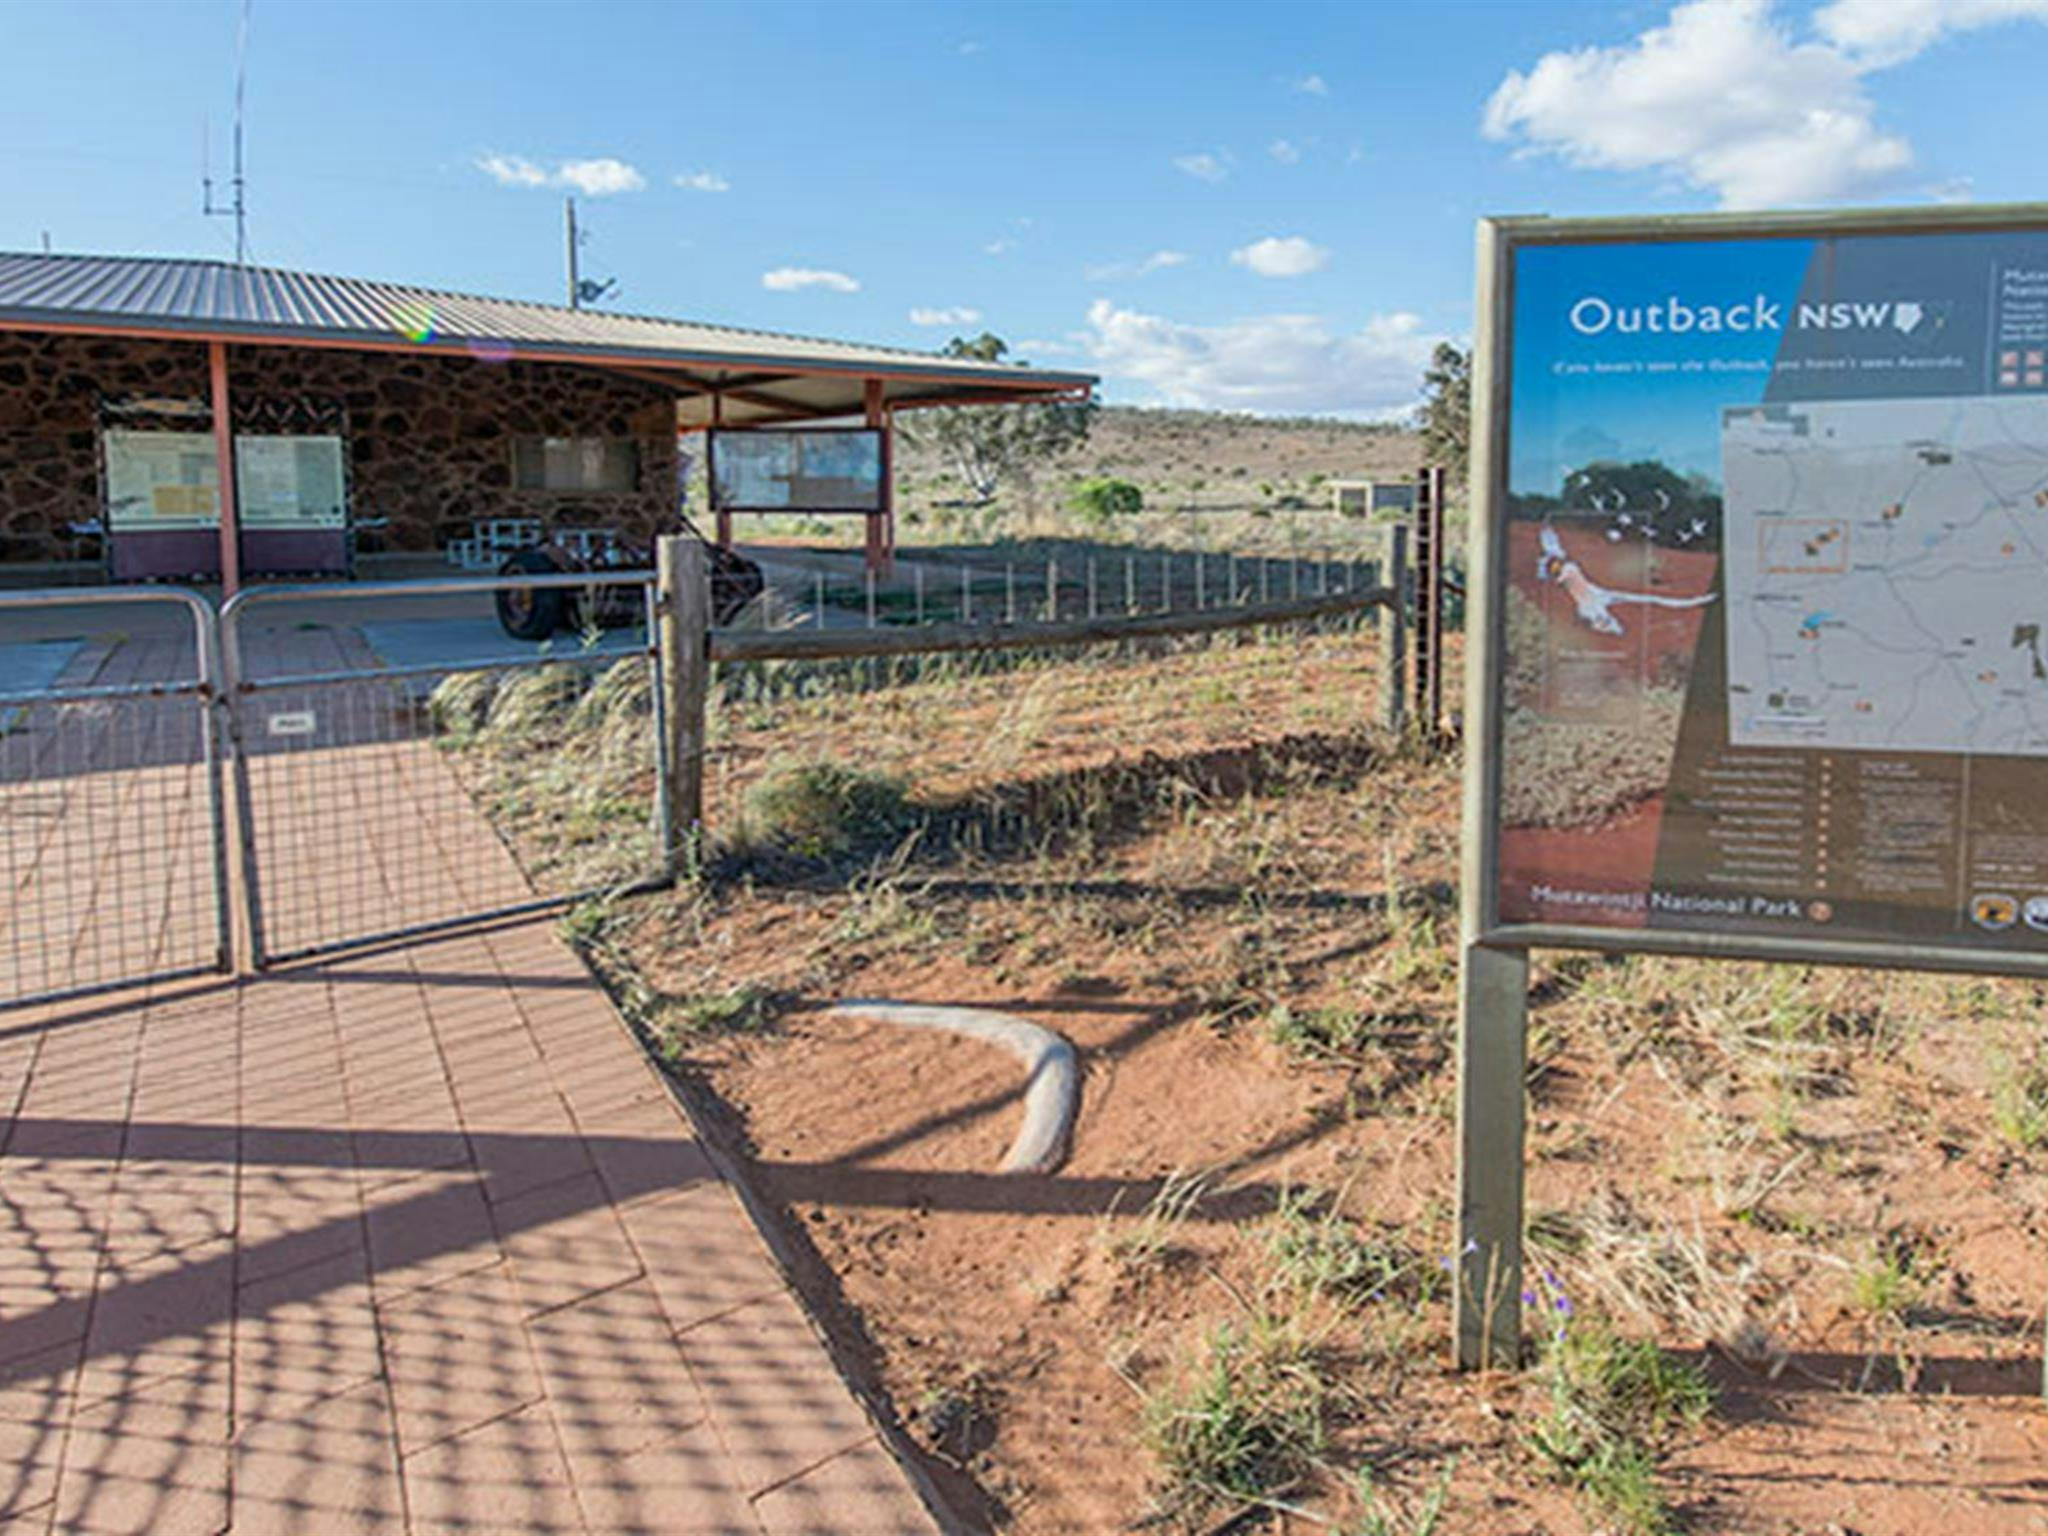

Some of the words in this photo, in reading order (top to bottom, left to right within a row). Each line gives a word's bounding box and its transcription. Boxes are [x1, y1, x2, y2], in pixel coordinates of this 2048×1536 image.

[1569, 294, 1781, 334] Outback
[1798, 302, 1890, 330] NSW
[1651, 892, 1745, 914] National
[1752, 896, 1801, 917] Park
